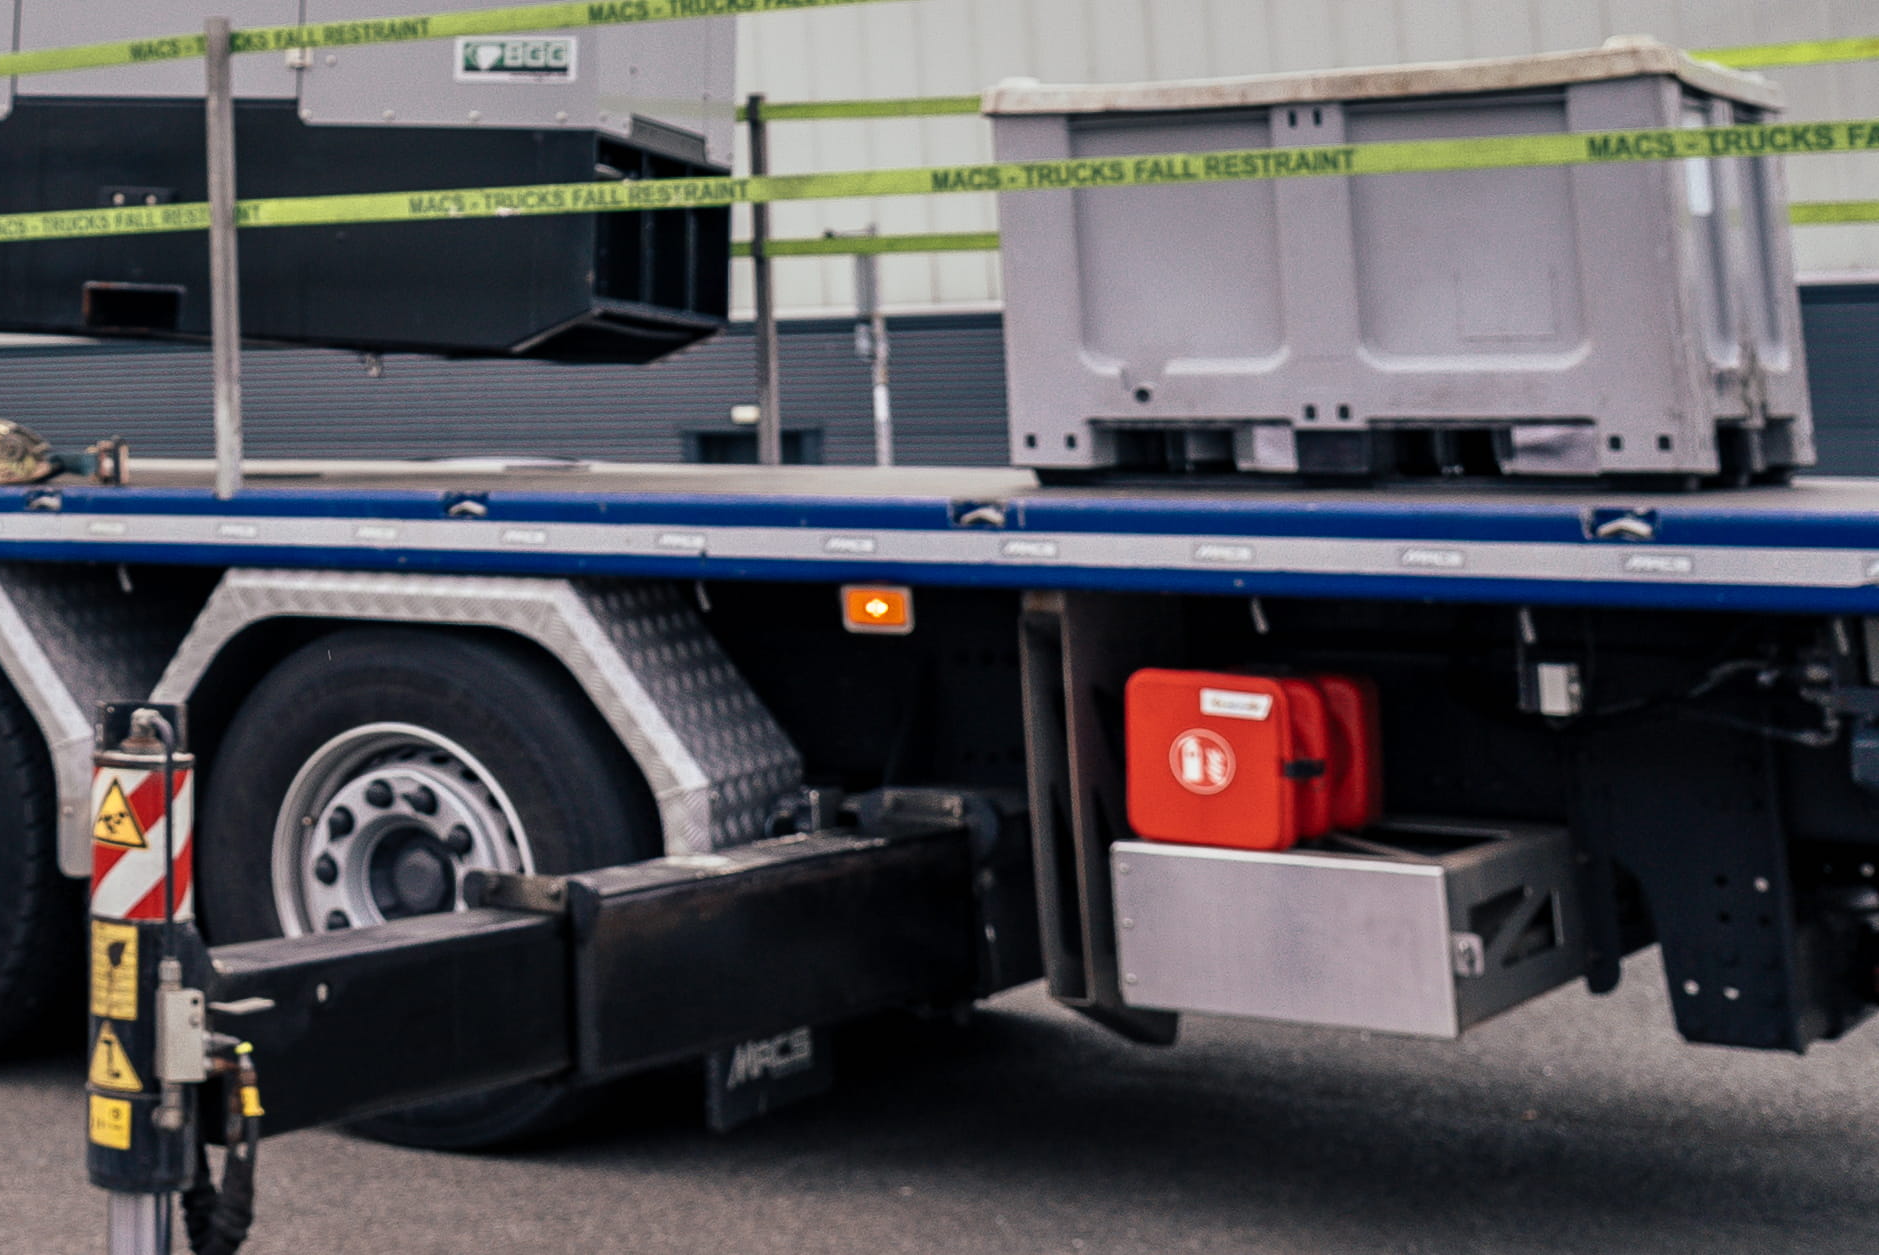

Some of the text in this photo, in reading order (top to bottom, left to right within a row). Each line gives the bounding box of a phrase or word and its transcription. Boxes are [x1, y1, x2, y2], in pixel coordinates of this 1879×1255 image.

[588, 0, 650, 24] MACS
[130, 38, 180, 62] MACS
[275, 26, 317, 48] FALL
[324, 17, 430, 45] RESTRAINT
[1587, 132, 1675, 159] MACS
[1705, 124, 1834, 155] TRUCKS
[931, 168, 1001, 192] MACS
[1023, 159, 1125, 187] TRUCKS
[1134, 157, 1196, 183] FALL
[1204, 147, 1356, 177] RESTRAINT
[408, 194, 465, 215] MACS
[484, 189, 565, 210] TRUCKS
[571, 186, 622, 208] FALL
[628, 179, 749, 203] RESTRAINT
[42, 215, 111, 234] TRUCKS
[115, 212, 155, 230] FALL
